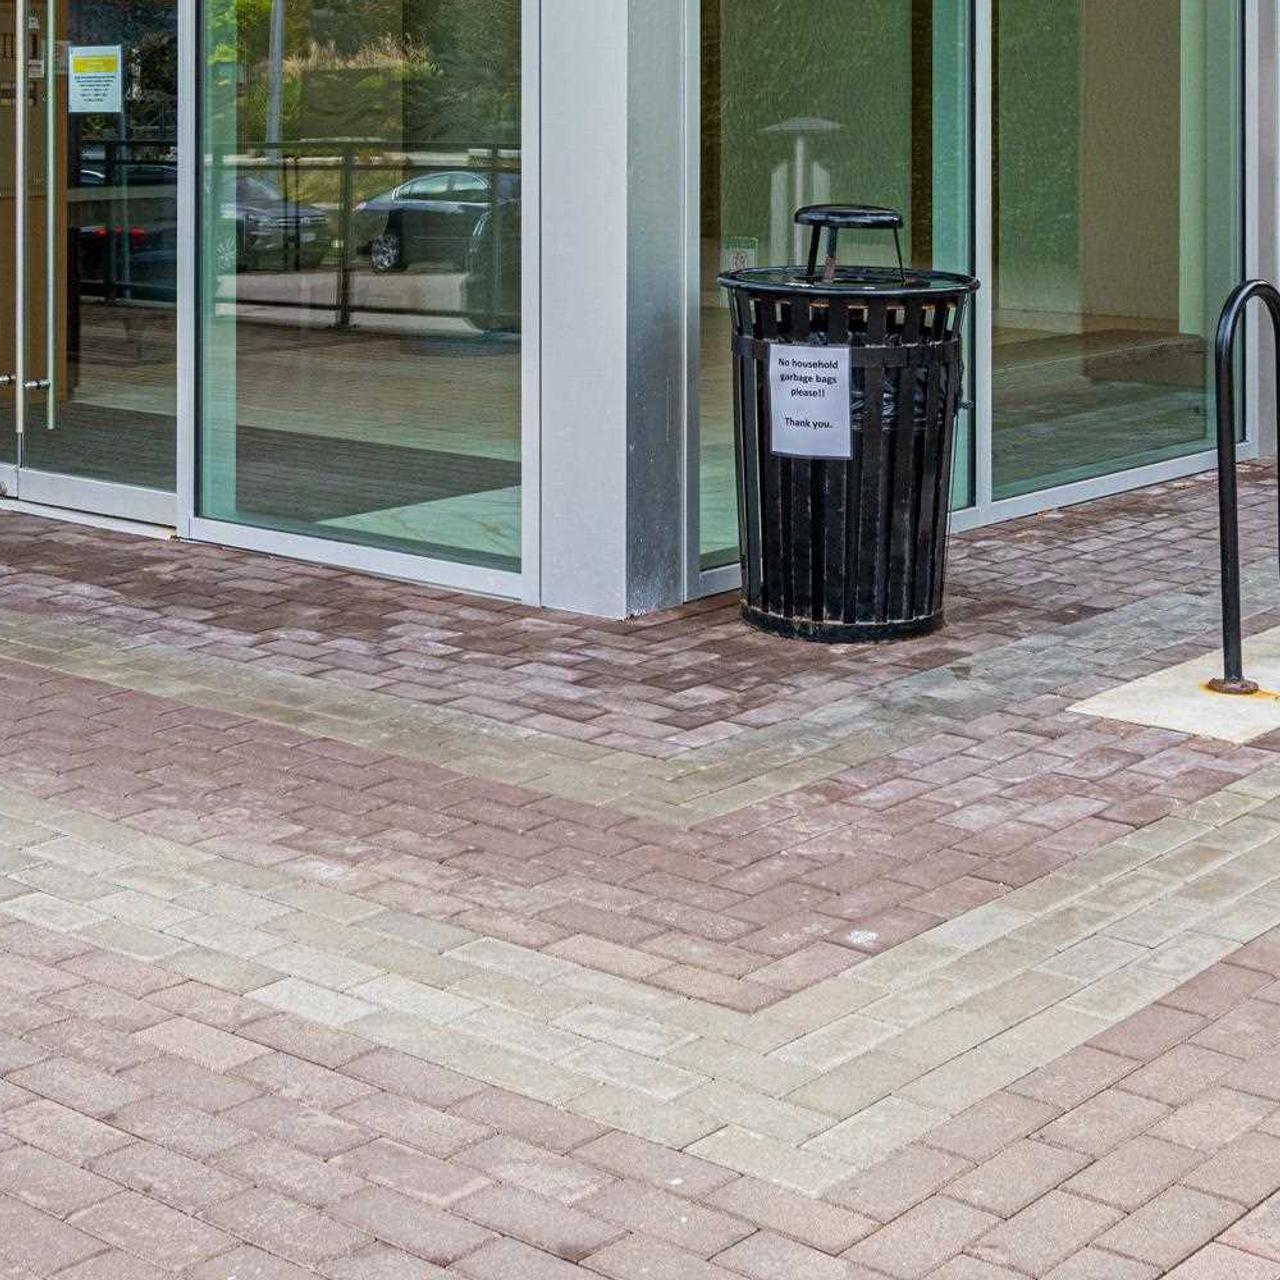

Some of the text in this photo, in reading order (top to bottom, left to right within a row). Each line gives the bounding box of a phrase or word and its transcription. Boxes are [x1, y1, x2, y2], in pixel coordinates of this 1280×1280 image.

[778, 358, 839, 369] No household
[780, 373, 837, 385] garbage bags
[791, 388, 825, 398] please!!
[785, 417, 833, 430] Thank you.
